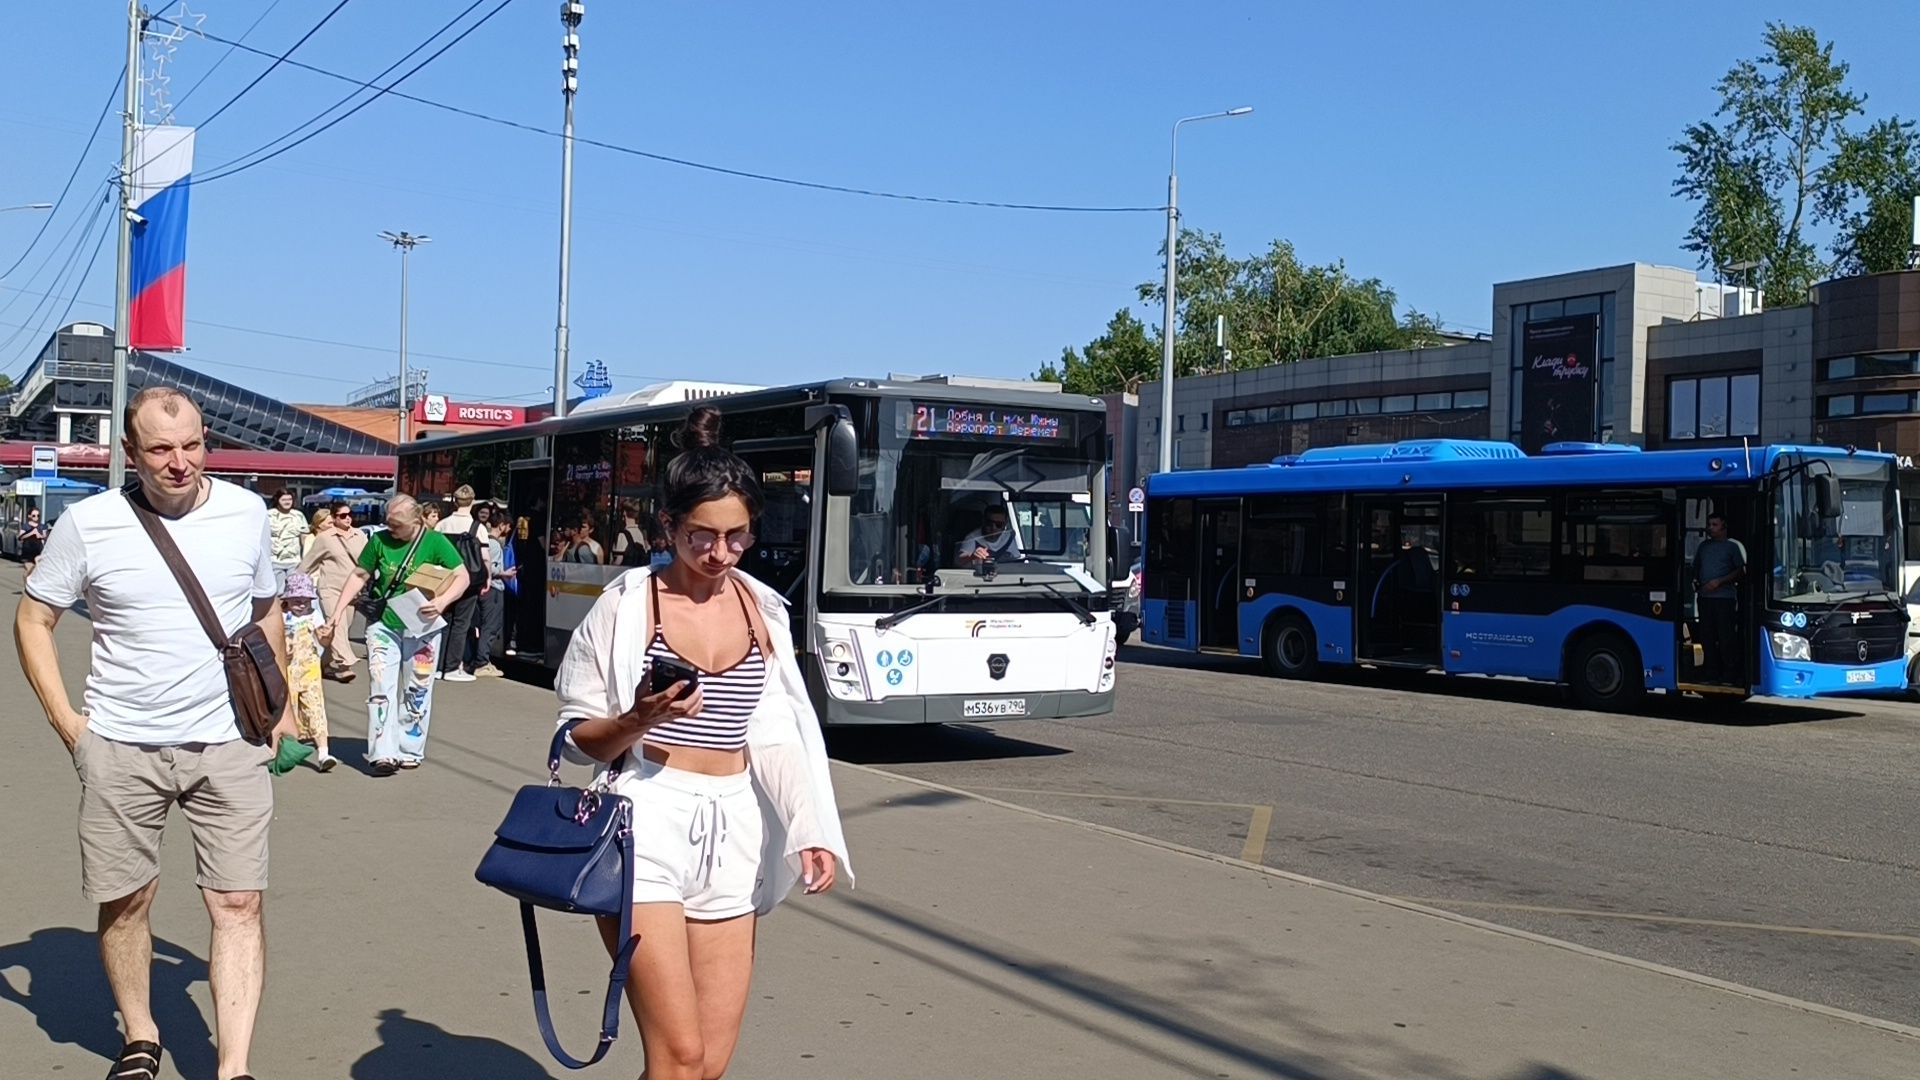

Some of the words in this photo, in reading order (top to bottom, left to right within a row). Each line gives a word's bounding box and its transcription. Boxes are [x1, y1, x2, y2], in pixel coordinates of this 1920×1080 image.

[459, 407, 513, 421] ROSTIC'S
[917, 406, 936, 432] 21
[947, 408, 983, 422] Лобня
[946, 420, 1003, 434] Аэропорт
[1010, 424, 1058, 438] Шеремет
